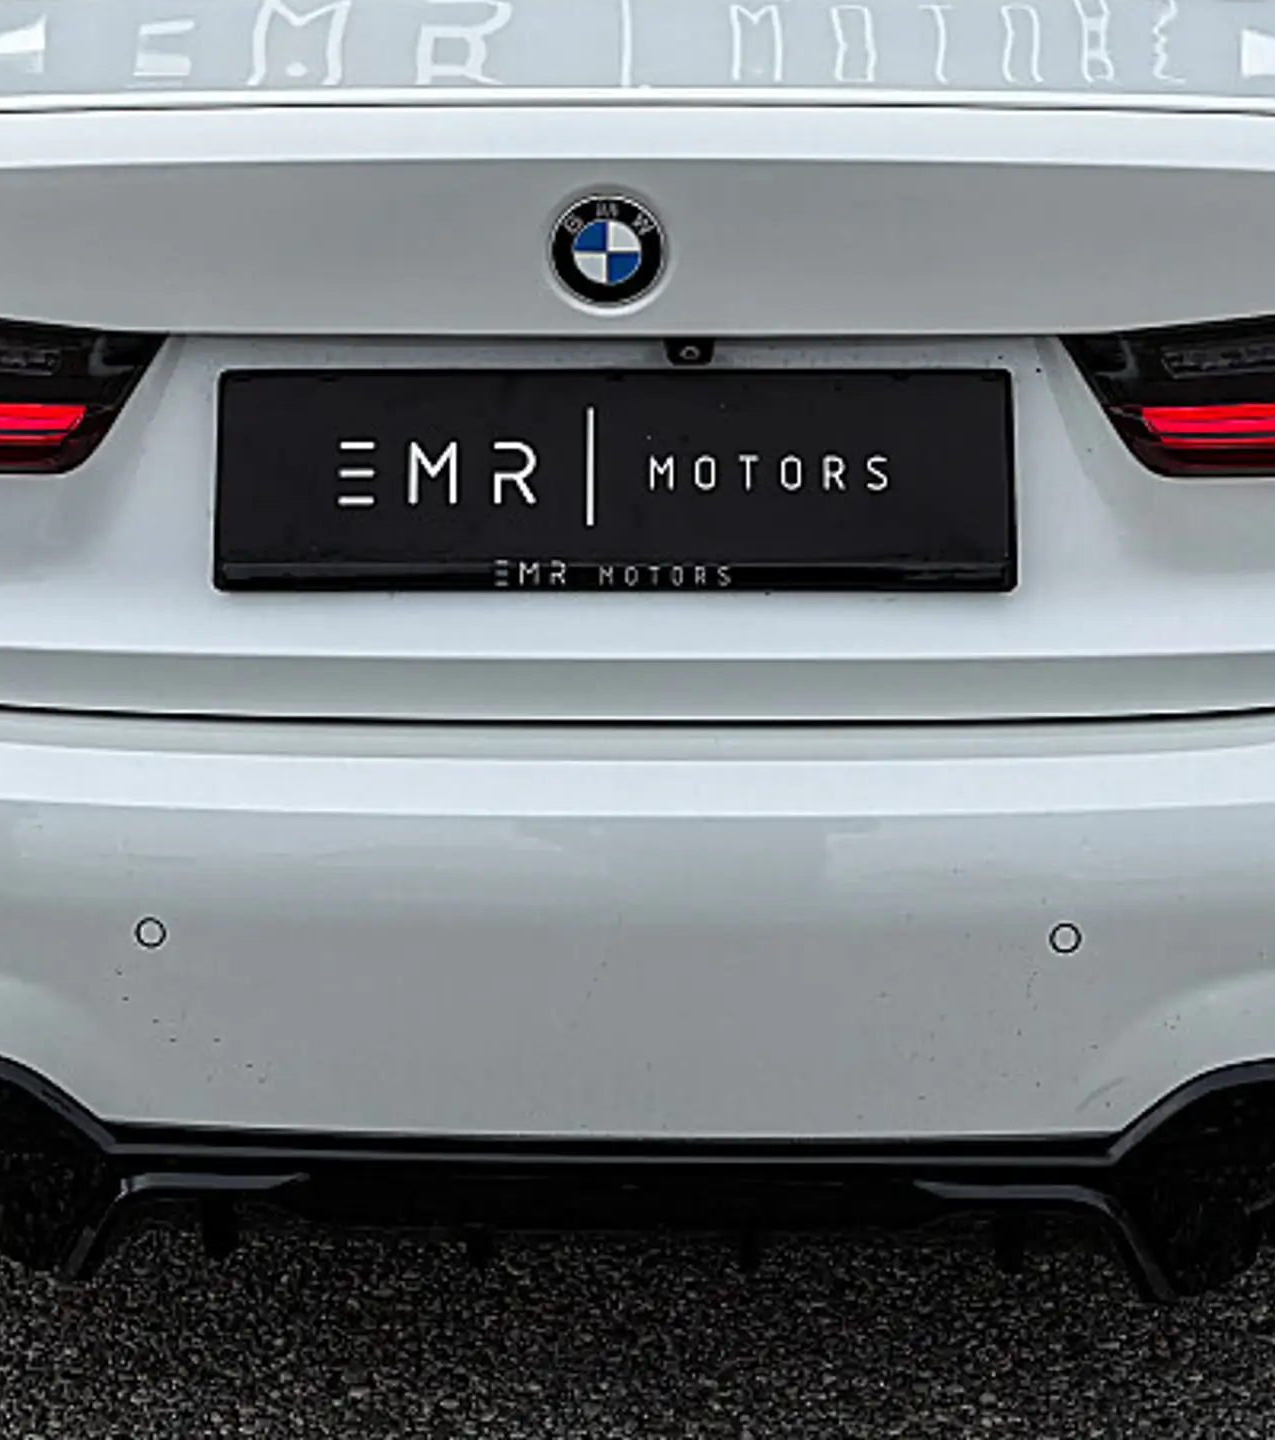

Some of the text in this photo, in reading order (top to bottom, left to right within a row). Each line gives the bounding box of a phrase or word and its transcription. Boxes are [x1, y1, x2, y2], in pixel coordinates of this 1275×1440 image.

[338, 441, 890, 506] EMR MOTORS
[494, 559, 732, 588] EMR MOTORS
